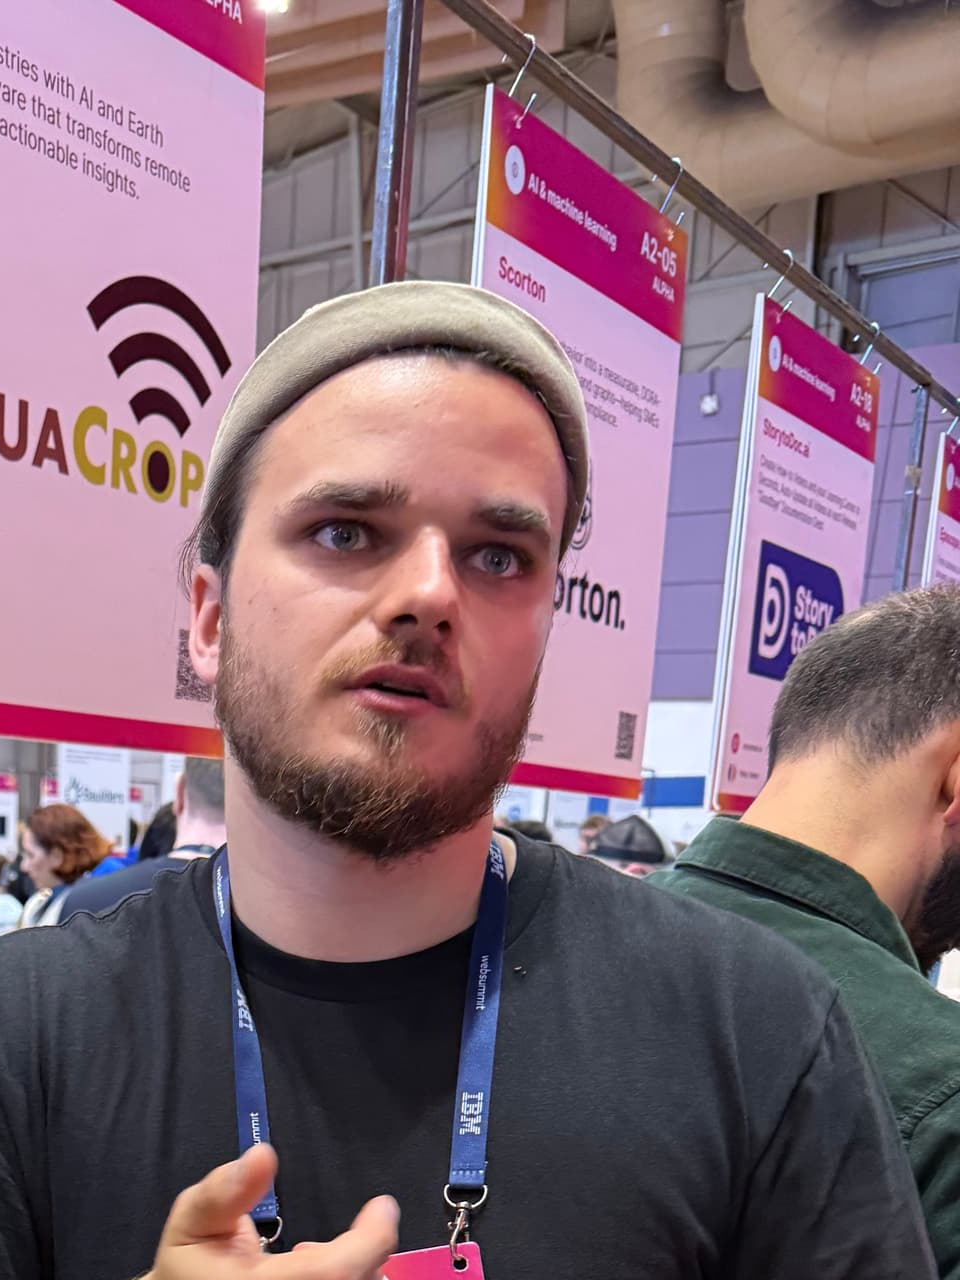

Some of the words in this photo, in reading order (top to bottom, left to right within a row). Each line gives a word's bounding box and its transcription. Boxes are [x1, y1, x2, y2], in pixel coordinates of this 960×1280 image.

[43, 69, 75, 102] with
[79, 85, 94, 112] AI
[97, 99, 124, 127] and
[128, 110, 164, 148] Earth
[0, 117, 78, 170] actionable
[82, 152, 140, 200] insights.
[31, 95, 62, 130] that
[66, 113, 141, 168] transforms
[144, 155, 191, 193] remote
[528, 172, 539, 194] AI
[540, 182, 547, 199] &
[547, 188, 585, 226] machine
[584, 210, 617, 253] learning
[498, 255, 546, 304] Scorton
[640, 231, 677, 279] A2-05
[652, 275, 675, 303] ALPHA
[794, 584, 835, 631] Story
[475, 954, 490, 1011] websummit
[459, 1090, 484, 1136] IBM
